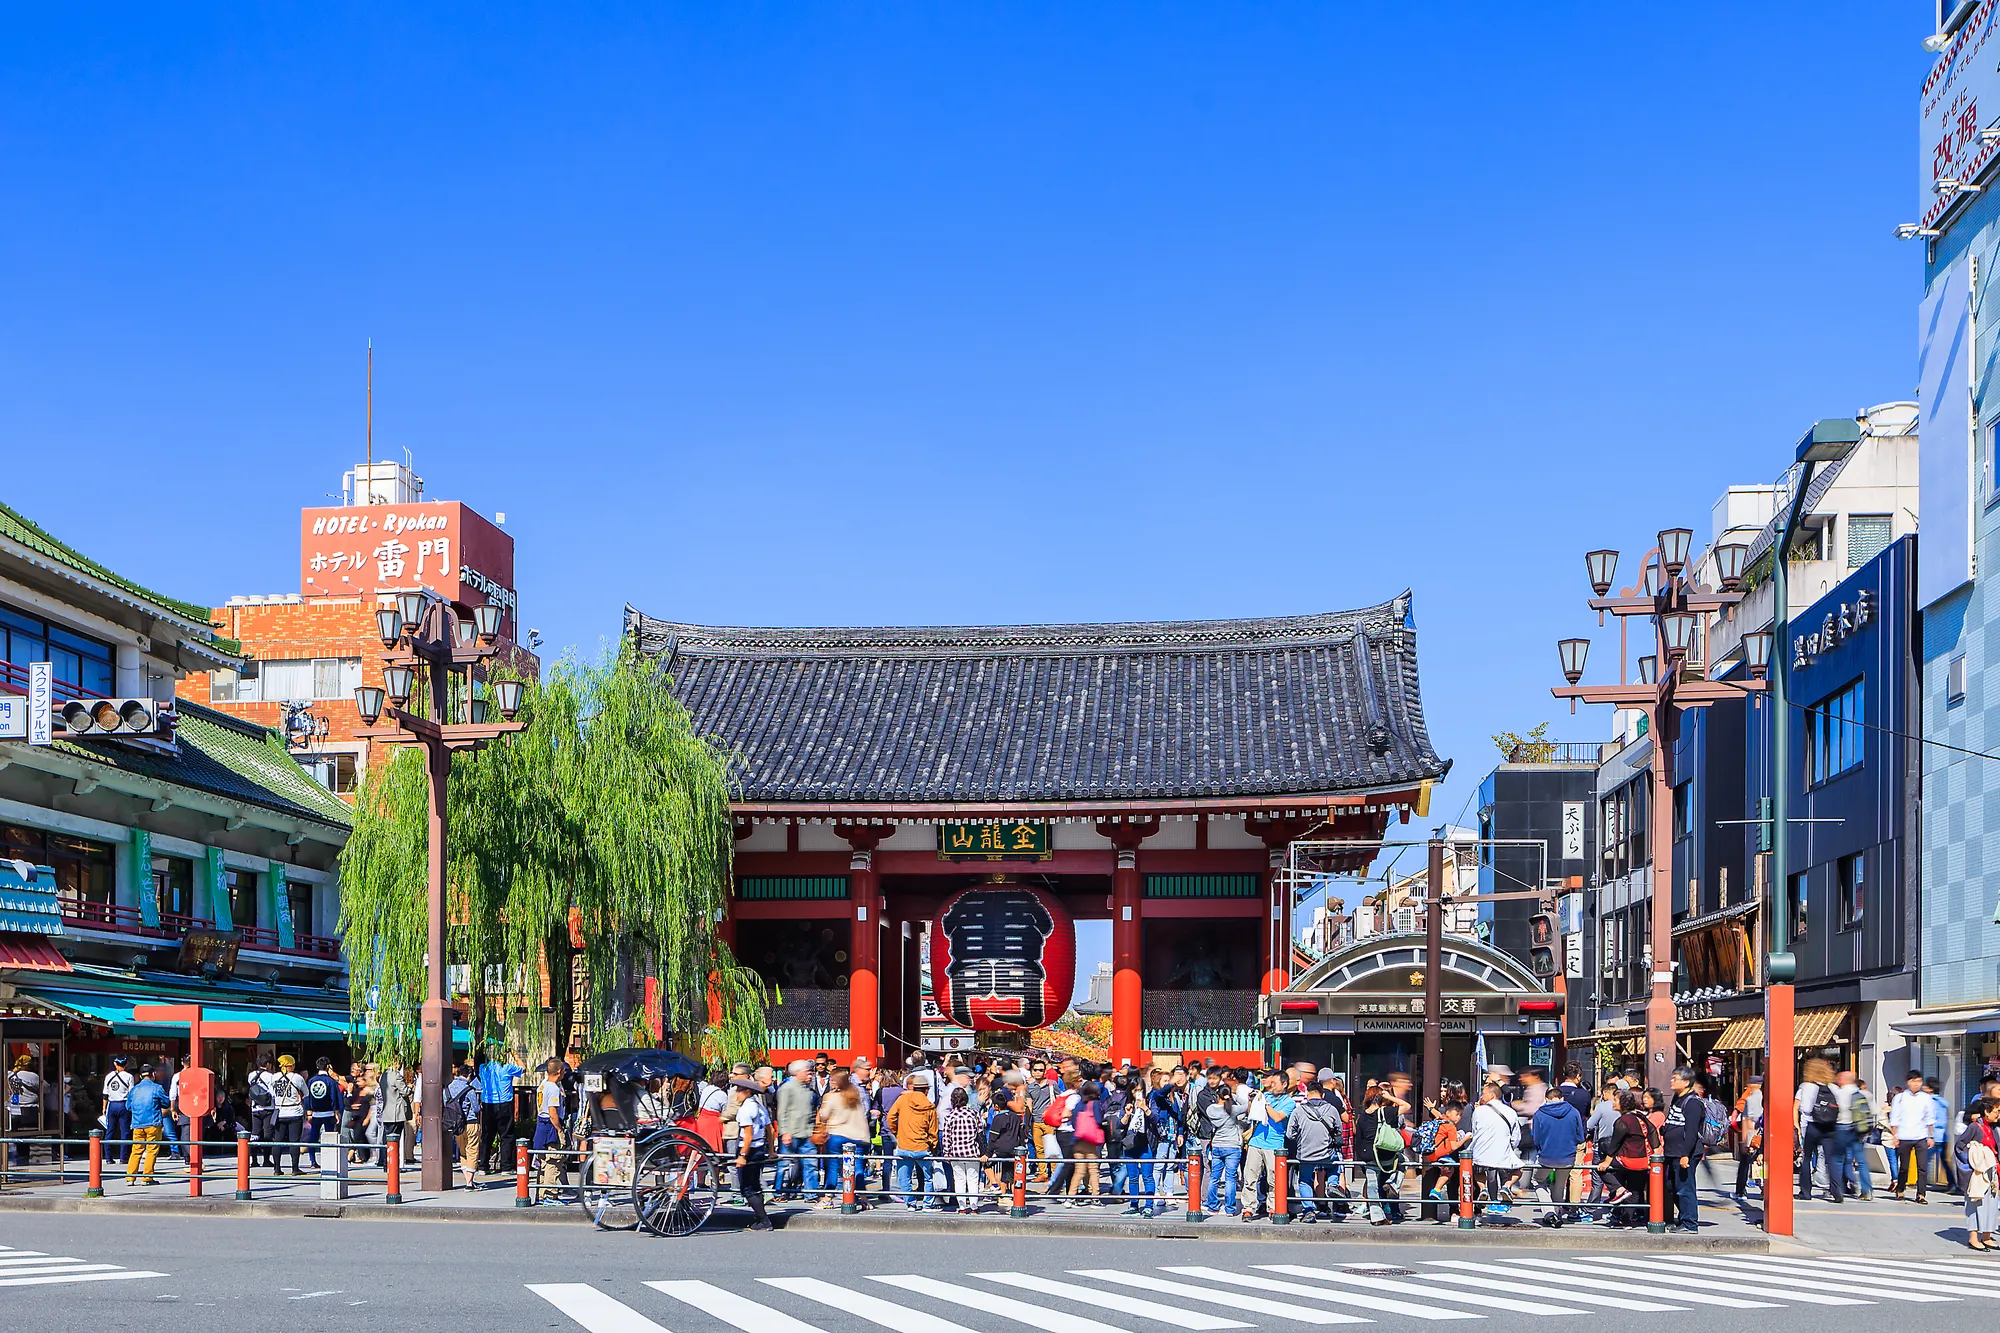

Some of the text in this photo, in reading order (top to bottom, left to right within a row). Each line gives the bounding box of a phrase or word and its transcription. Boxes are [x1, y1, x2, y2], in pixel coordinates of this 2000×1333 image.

[1942, 86, 1967, 130] かぜに
[1933, 96, 1978, 181] 改源
[312, 512, 449, 535] HOTEL Ryokan
[34, 666, 46, 741] スクランブル式
[942, 889, 1054, 1028] 雷門
[1363, 1021, 1425, 1030] KAMINARIMO
[1411, 998, 1476, 1013] 雷交番
